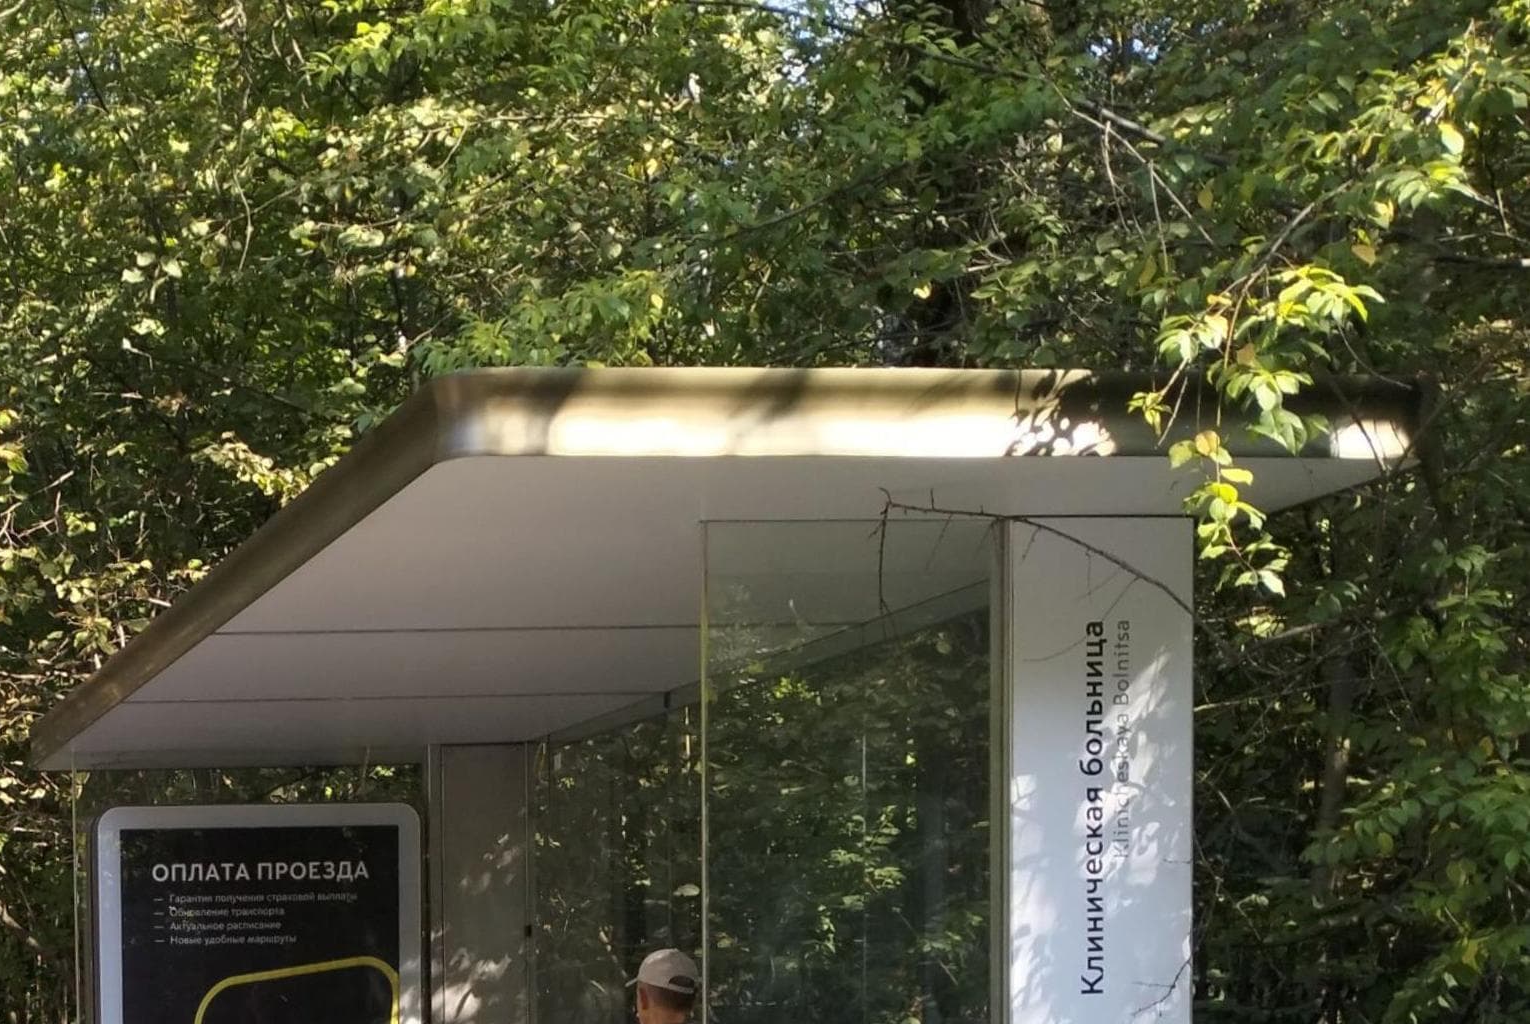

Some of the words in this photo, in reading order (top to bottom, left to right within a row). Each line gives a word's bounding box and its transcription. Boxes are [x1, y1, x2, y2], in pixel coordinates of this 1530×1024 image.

[1112, 620, 1130, 706] Bolnitsa
[1079, 620, 1107, 775] больница
[1112, 714, 1132, 858] Klinicheskaya
[152, 862, 250, 882] ОПЛАТА
[257, 860, 369, 883] ПРОЕЗДА
[169, 893, 213, 904] Гарантия
[215, 893, 264, 904] получения
[266, 891, 316, 903] страховой
[1081, 786, 1104, 994] Клиническая
[231, 906, 285, 919] транспорта
[169, 921, 224, 933] Актуальное
[226, 920, 282, 932] расписание
[170, 935, 202, 945] Новые
[204, 933, 245, 946] удобные
[247, 933, 297, 946] маршруты
